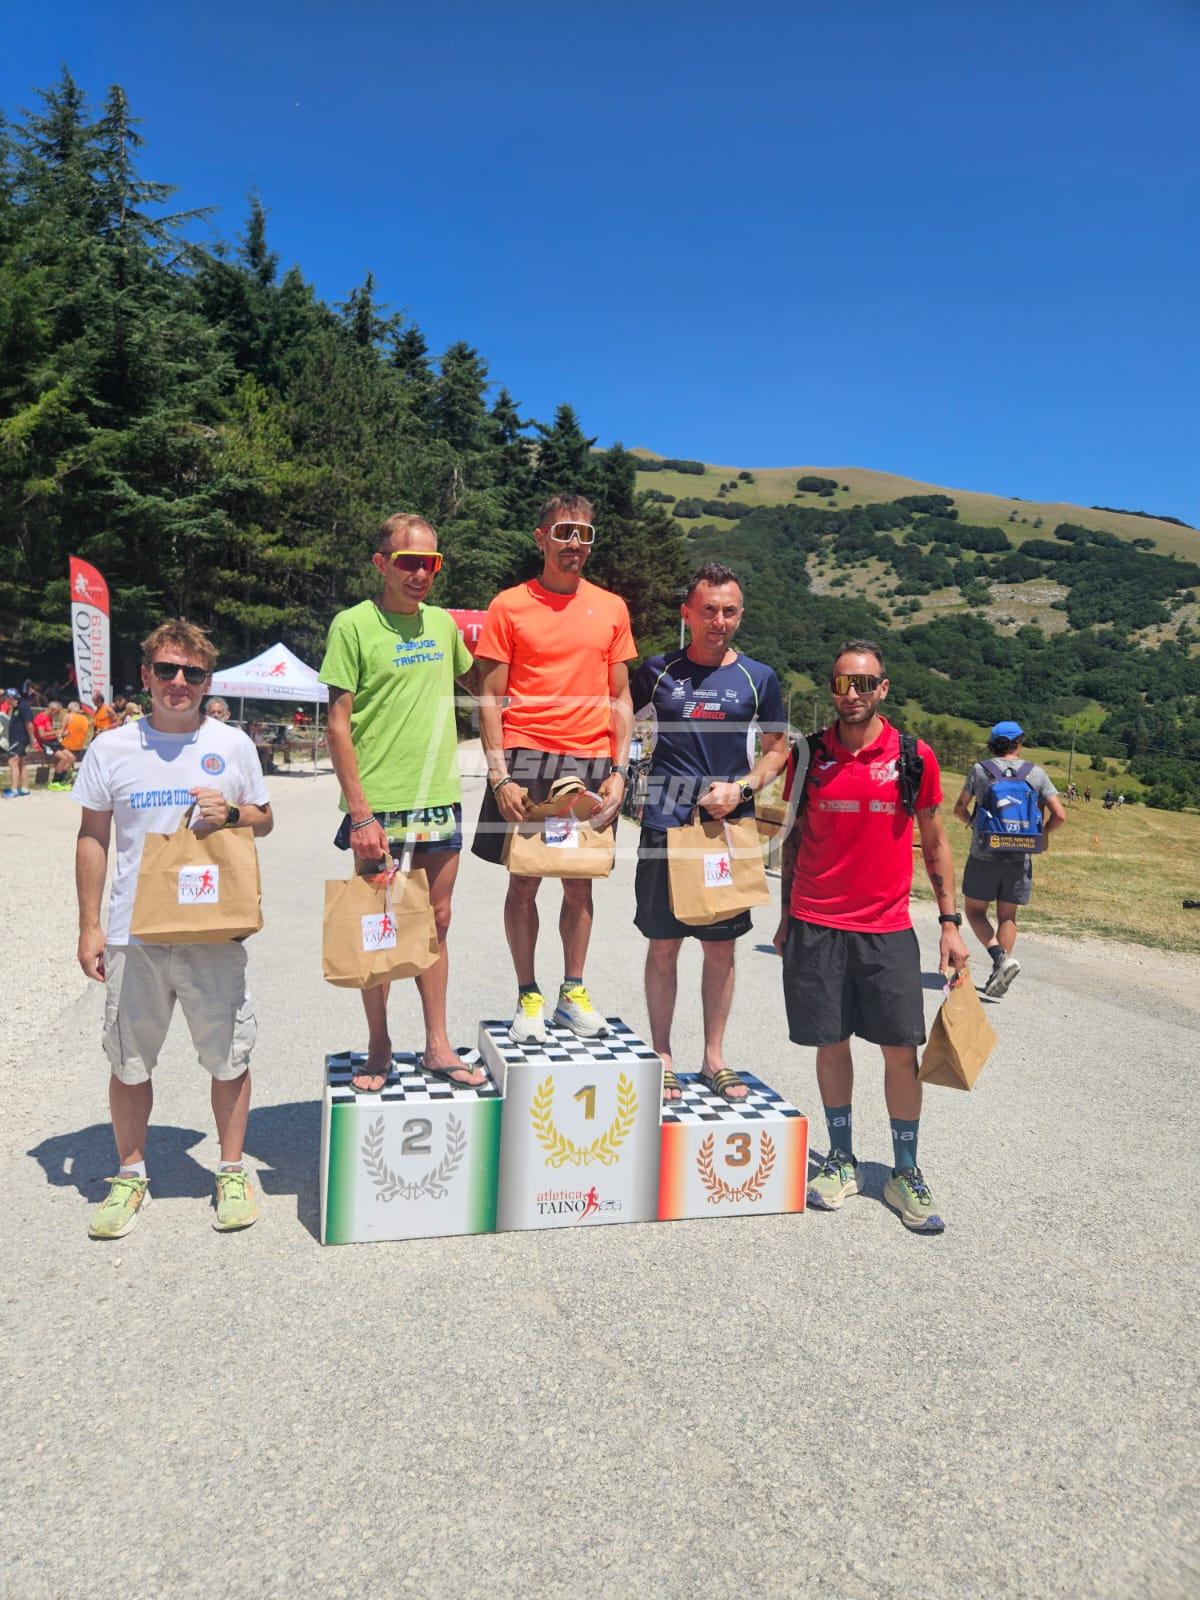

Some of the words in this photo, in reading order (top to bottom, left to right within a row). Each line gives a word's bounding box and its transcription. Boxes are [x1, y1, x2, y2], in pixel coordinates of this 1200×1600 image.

[573, 1084, 596, 1120] 1
[401, 1118, 433, 1156] 2
[725, 1132, 752, 1168] 3
[536, 1187, 582, 1202] atletica
[536, 1199, 586, 1215] TAINO
